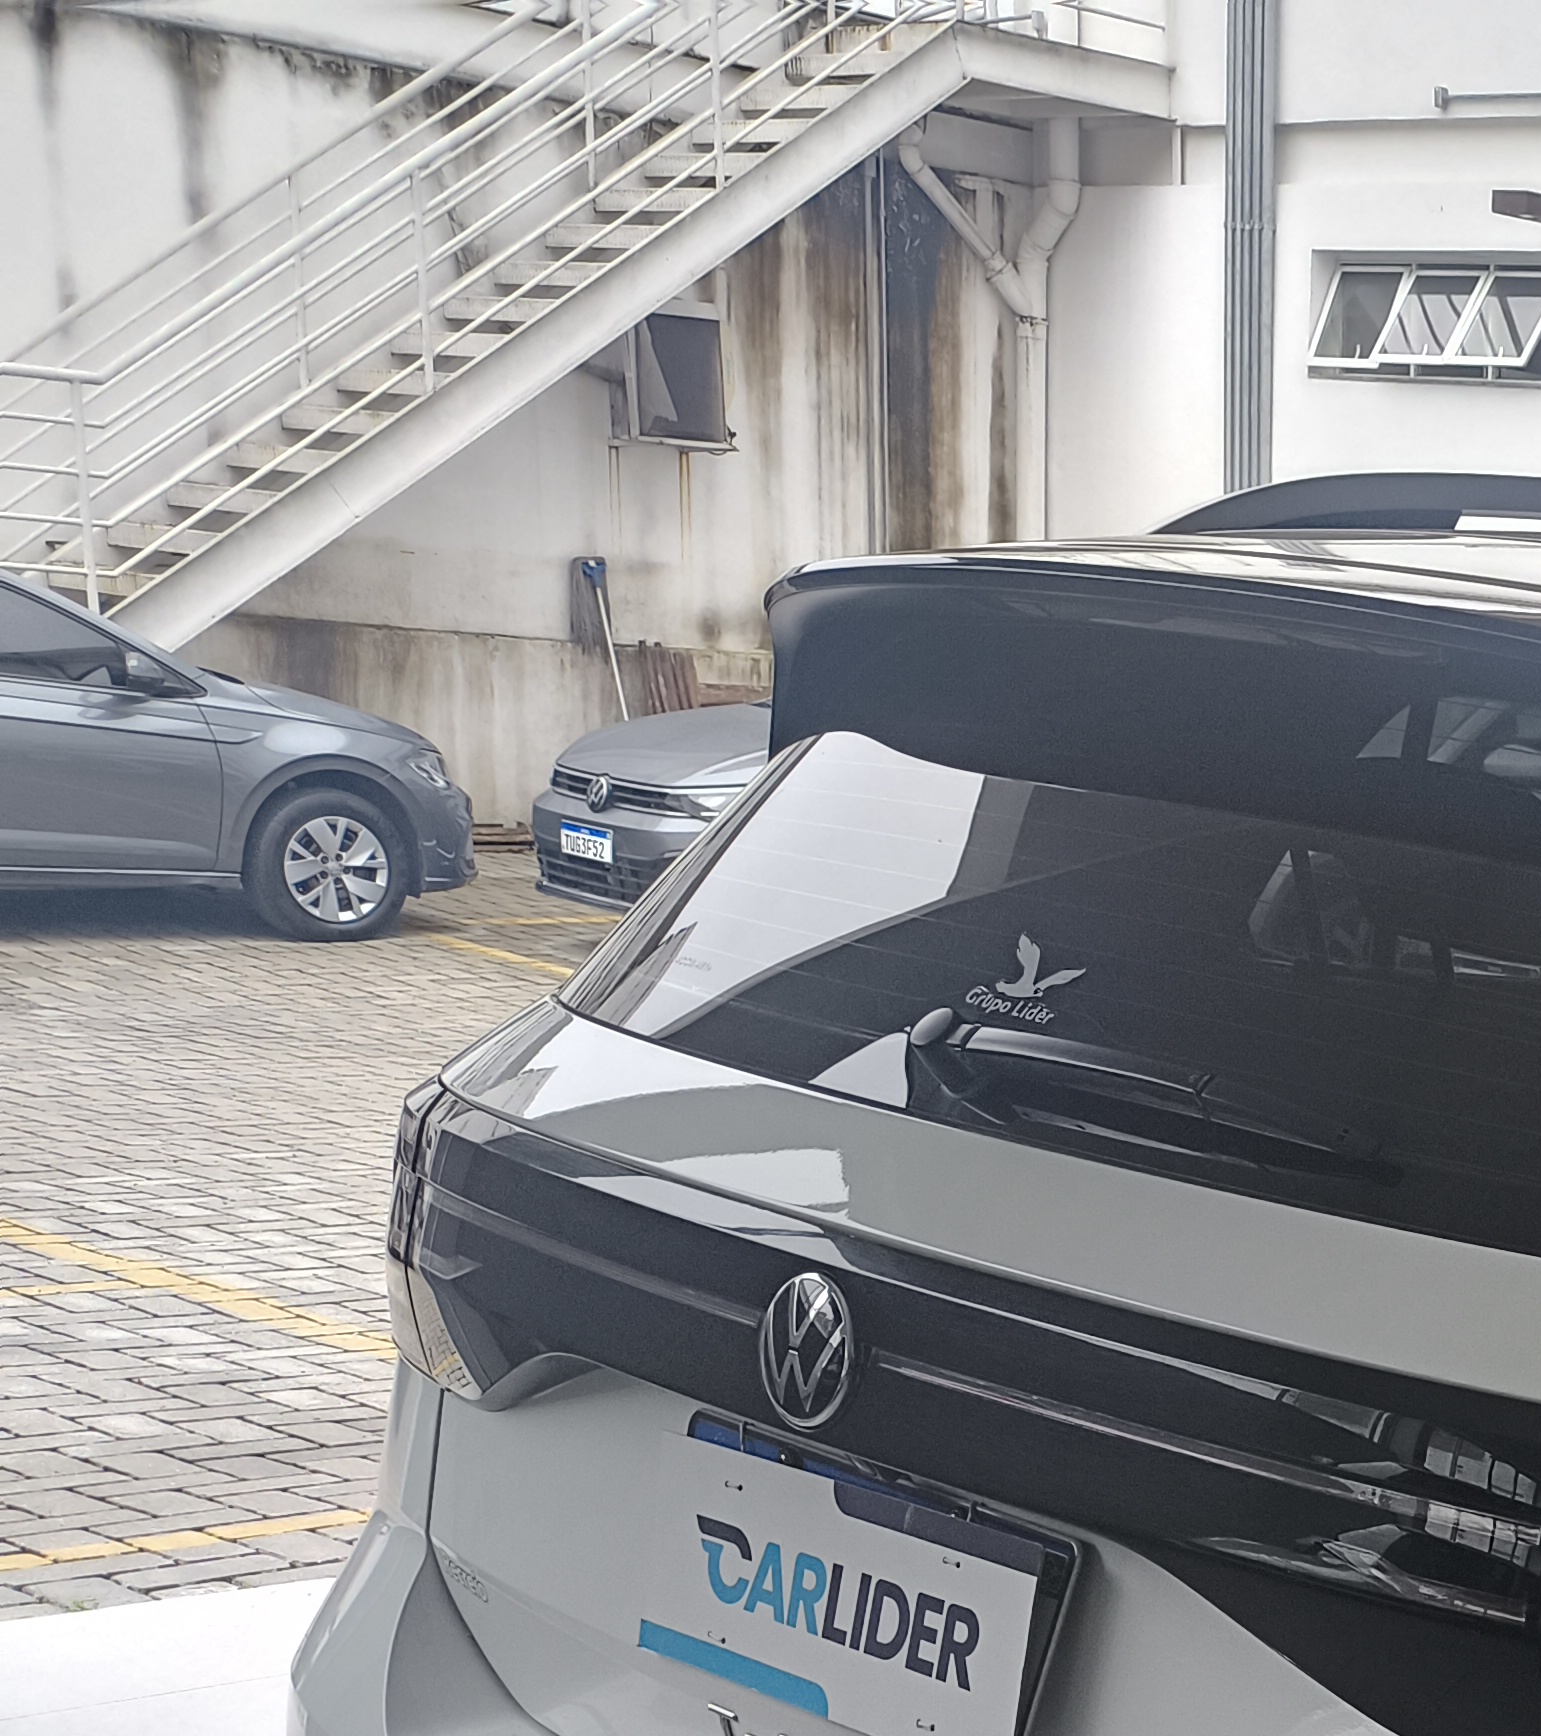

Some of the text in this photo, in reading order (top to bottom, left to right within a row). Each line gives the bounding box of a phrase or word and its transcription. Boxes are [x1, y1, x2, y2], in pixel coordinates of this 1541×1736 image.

[564, 833, 605, 859] TUG3F52
[965, 986, 1012, 1013] Grupo
[696, 1513, 980, 1692] CARLIDER
